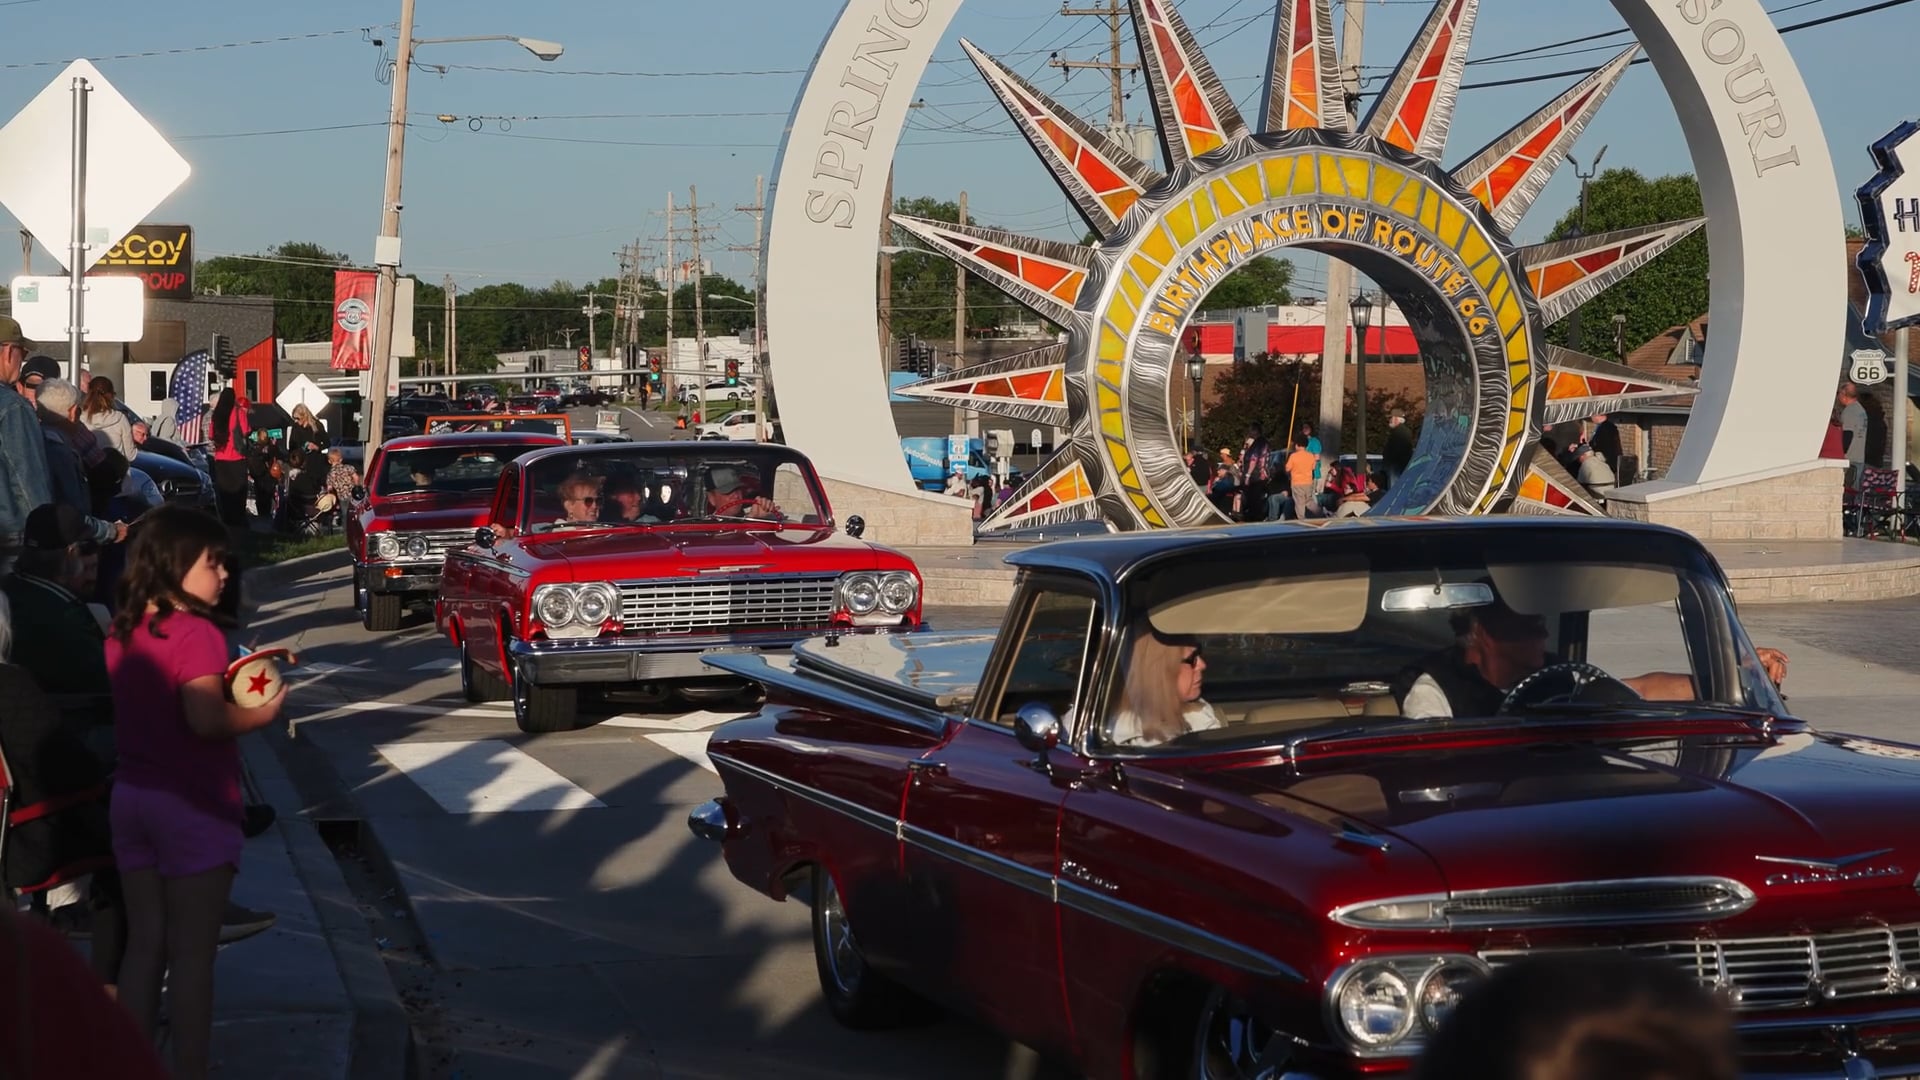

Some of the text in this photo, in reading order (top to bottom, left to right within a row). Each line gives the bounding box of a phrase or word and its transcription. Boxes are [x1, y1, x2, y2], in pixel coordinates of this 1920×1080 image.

[107, 232, 188, 265] cCoy
[1150, 210, 1491, 336] BIRTHPLACE OF ROUTE 66
[1857, 366, 1880, 380] 66
